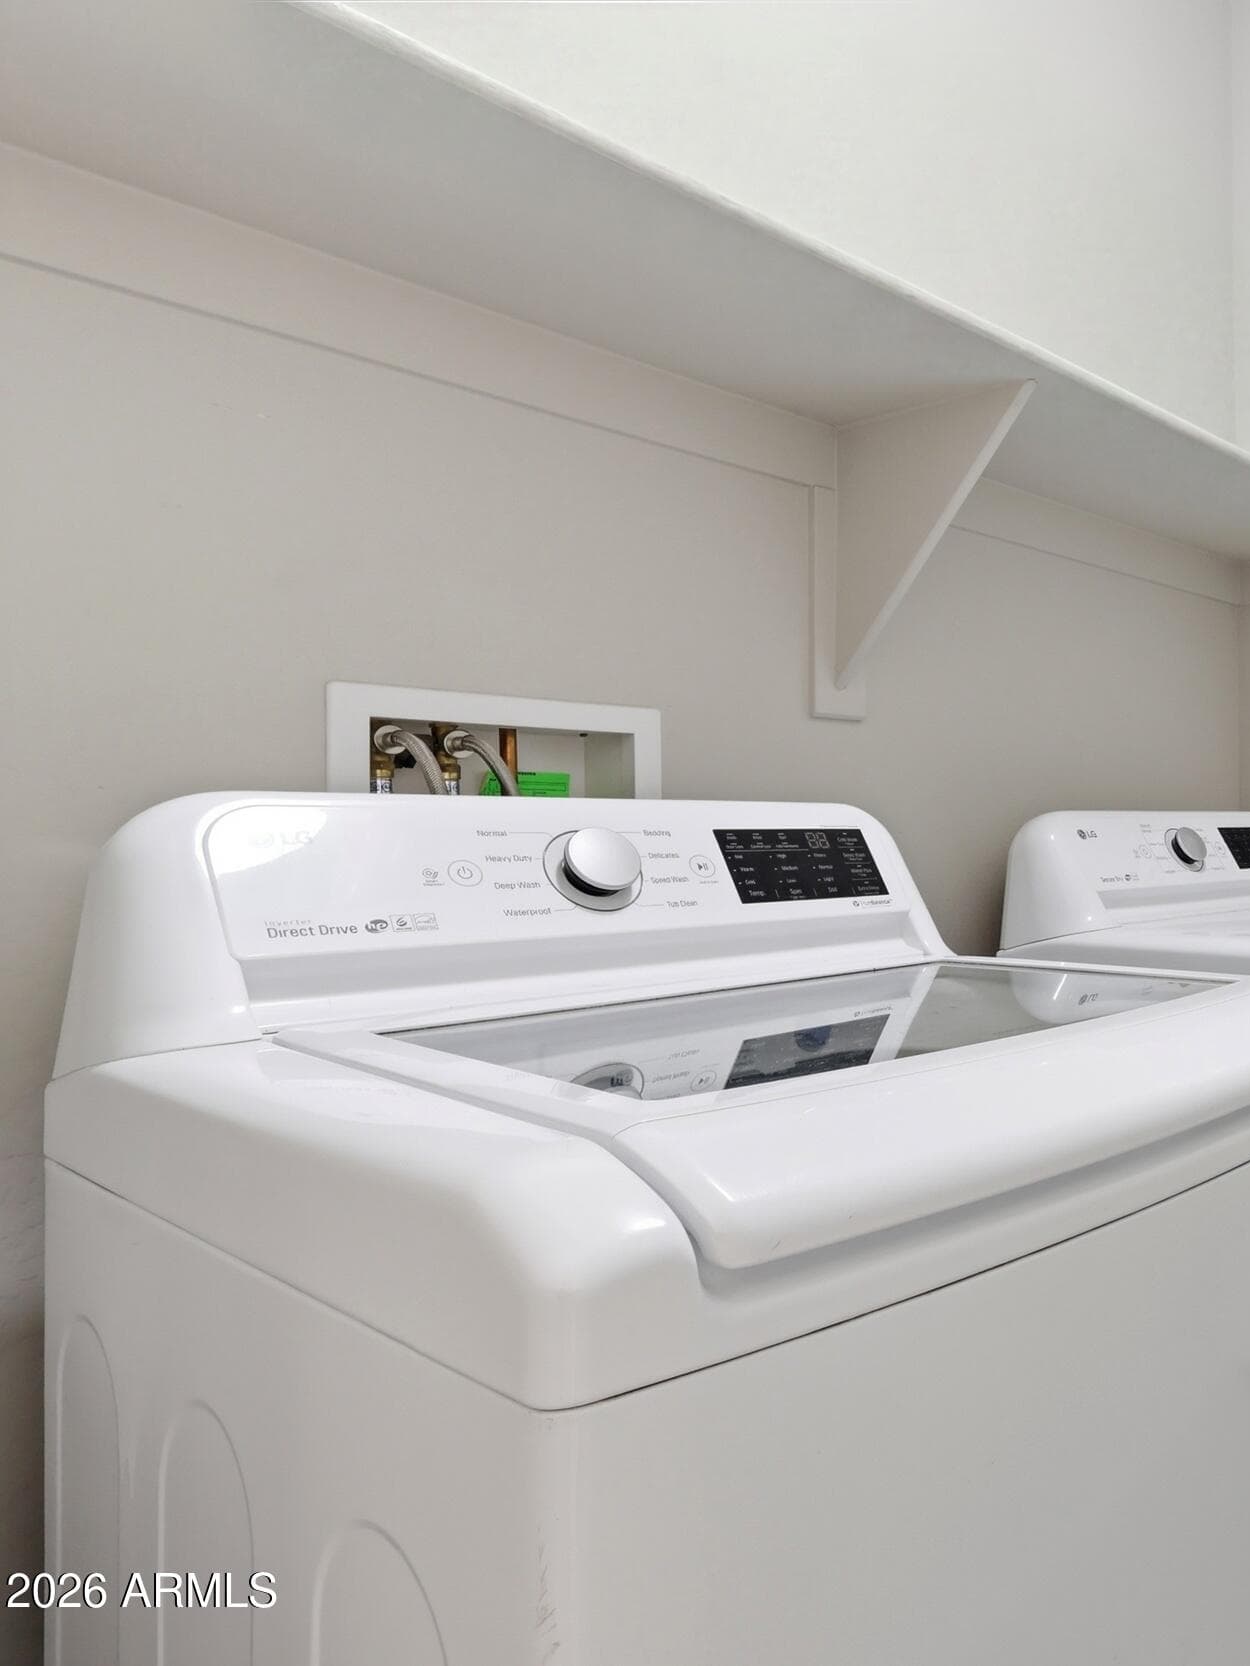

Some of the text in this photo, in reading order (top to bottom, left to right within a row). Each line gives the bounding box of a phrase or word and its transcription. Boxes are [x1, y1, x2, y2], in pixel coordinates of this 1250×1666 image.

[476, 829, 508, 837] Normal
[485, 854, 533, 863] Heavy Duty
[493, 880, 541, 890] Deep Wash
[503, 907, 552, 917] Waterproof
[267, 924, 359, 939] Direct Drive
